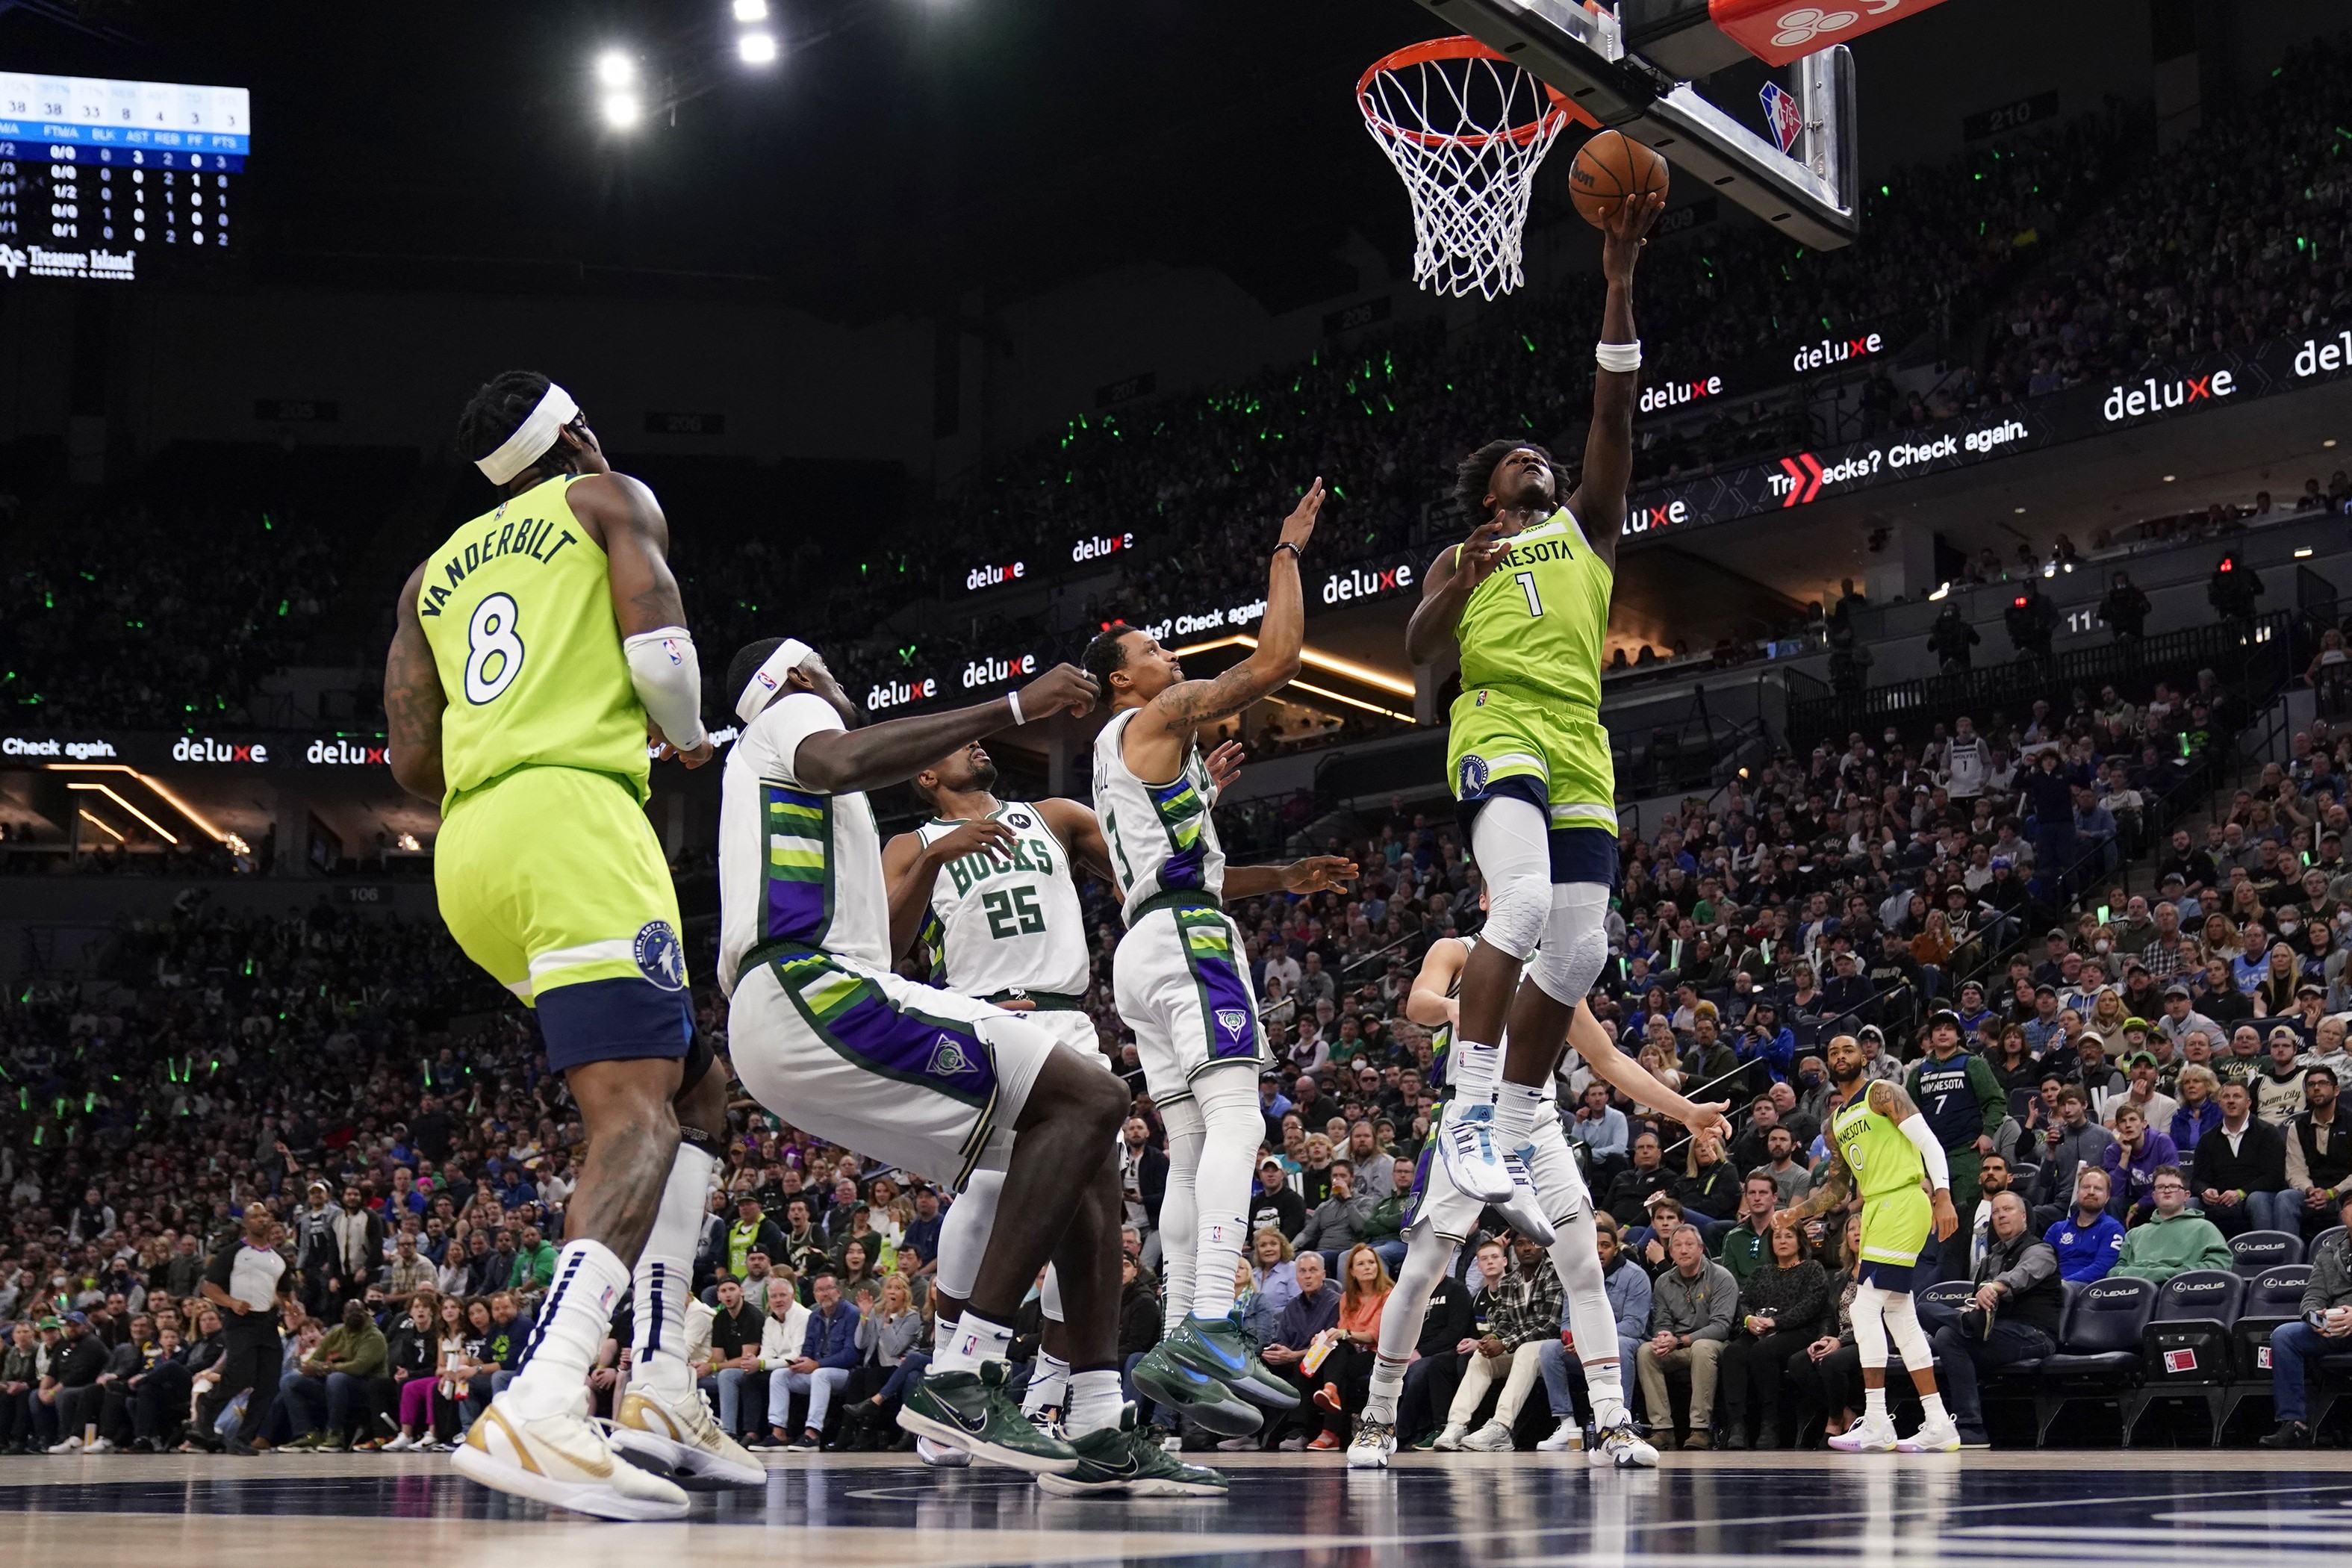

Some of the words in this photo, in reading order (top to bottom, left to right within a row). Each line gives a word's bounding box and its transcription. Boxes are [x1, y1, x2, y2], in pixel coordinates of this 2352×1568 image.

[1990, 102, 2031, 131] 210
[125, 130, 149, 143] AST
[187, 133, 204, 146] PF
[212, 135, 237, 149] PTS
[50, 145, 76, 161] 0/0
[100, 148, 112, 162] 0
[133, 149, 144, 165] 3
[163, 152, 174, 167] 2
[190, 153, 202, 168] 0
[51, 164, 77, 180] 0/0
[100, 167, 111, 181] 0
[132, 169, 144, 184] 0
[163, 171, 175, 186] 2
[191, 173, 200, 187] 1
[52, 184, 78, 199] 1/2
[101, 187, 112, 201] 0
[135, 189, 144, 203] 1
[165, 191, 174, 205] 1
[191, 192, 202, 206] 0
[217, 193, 227, 208] 1
[52, 203, 78, 219] 0/0
[102, 206, 111, 220] 1
[134, 208, 145, 223] 0
[166, 210, 175, 224] 1
[191, 211, 202, 225] 0
[52, 223, 78, 238] 0/1
[134, 227, 146, 242] 0
[166, 229, 176, 243] 2
[193, 231, 204, 245] 0
[217, 232, 228, 246] 2
[27, 245, 88, 269] Treasure
[90, 249, 137, 271] Island
[1793, 333, 1884, 372] deluxe
[1639, 376, 1723, 412] deluxe
[2104, 370, 2233, 421] deluxe
[1888, 434, 1959, 468] Check
[1964, 419, 2029, 453] again.
[422, 517, 578, 618] VANDERBILT
[967, 561, 1025, 591] deluxe
[1323, 564, 1413, 604] deluxe
[1515, 570, 1544, 617] 1
[1175, 608, 1224, 636] Check
[464, 591, 526, 706] 8
[963, 653, 1036, 688] deluxe
[868, 676, 937, 710] deluxe
[3, 737, 60, 756] Check
[65, 738, 117, 760] again.
[173, 737, 267, 762] deluxe
[349, 887, 379, 902] 106
[981, 884, 1048, 941] 25
[1921, 1078, 1964, 1095] MINNESOTA
[1935, 1094, 1948, 1115] 7
[1848, 1142, 1864, 1172] 0
[2110, 1233, 2124, 1251] 2
[2248, 1242, 2286, 1251] LEXUS
[2103, 1287, 2140, 1298] LEXUS
[2187, 1281, 2225, 1291] LEXUS
